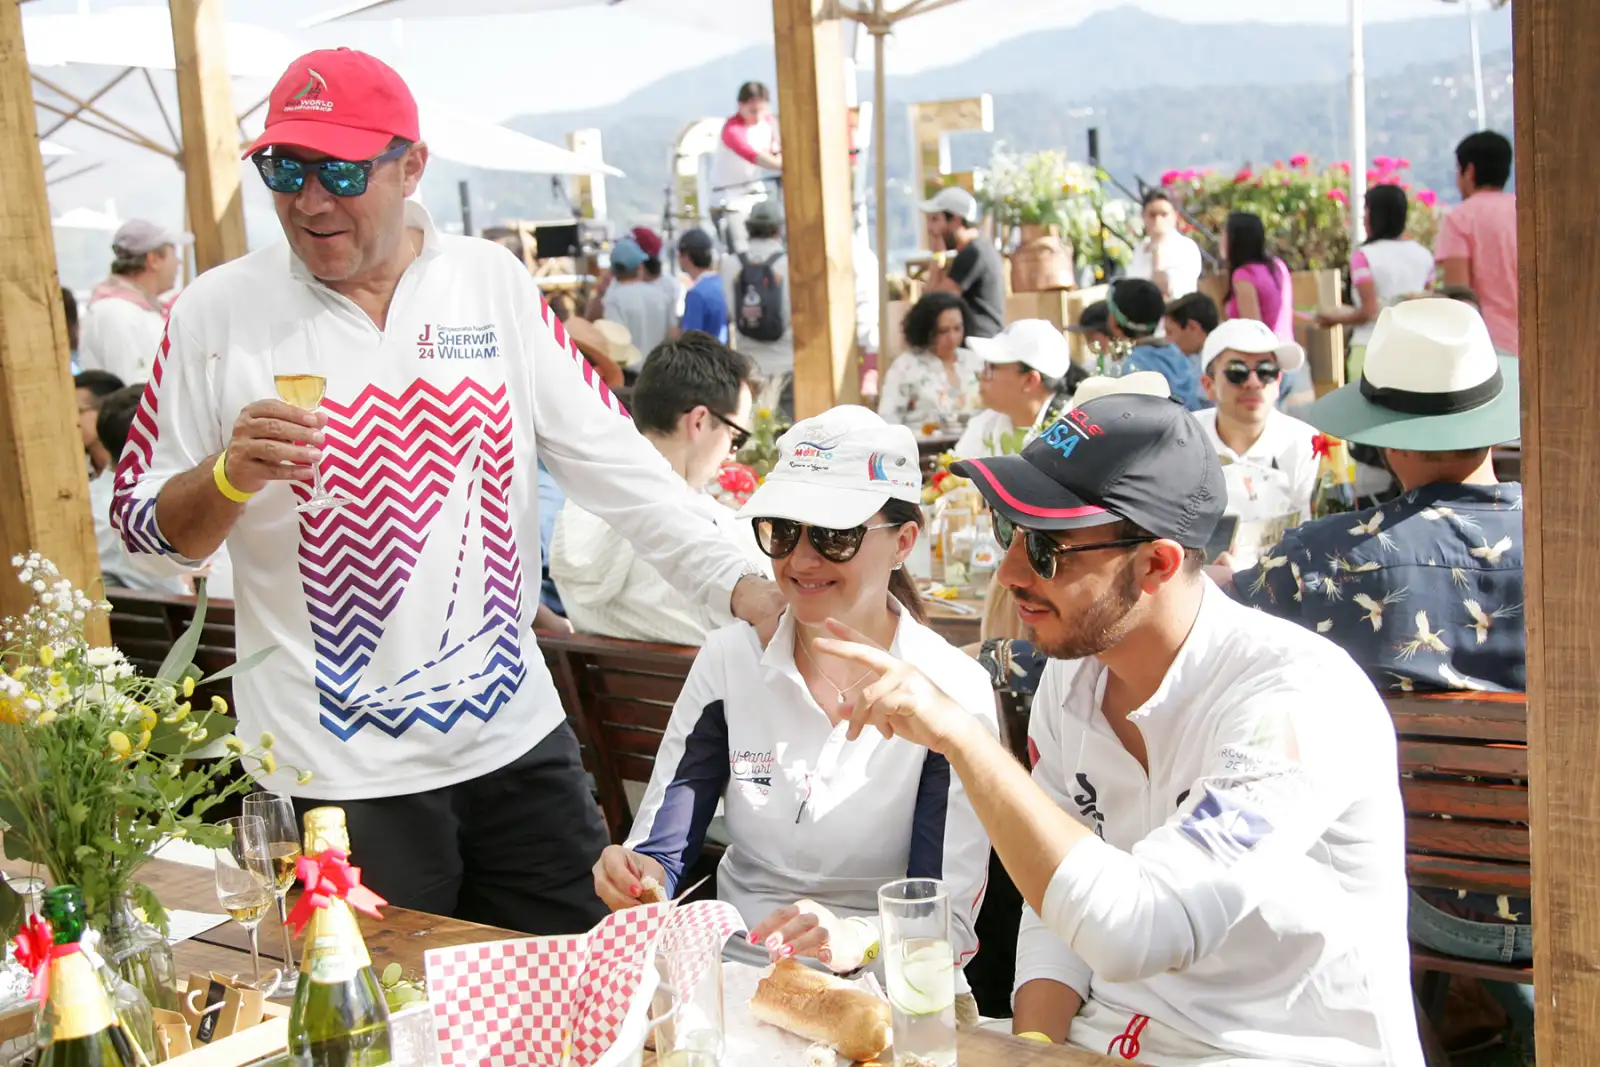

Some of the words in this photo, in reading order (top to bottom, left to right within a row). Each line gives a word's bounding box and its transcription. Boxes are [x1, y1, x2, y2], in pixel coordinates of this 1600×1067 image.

[418, 324, 432, 342] J
[437, 331, 497, 346] SHERWIN
[418, 347, 435, 359] 24
